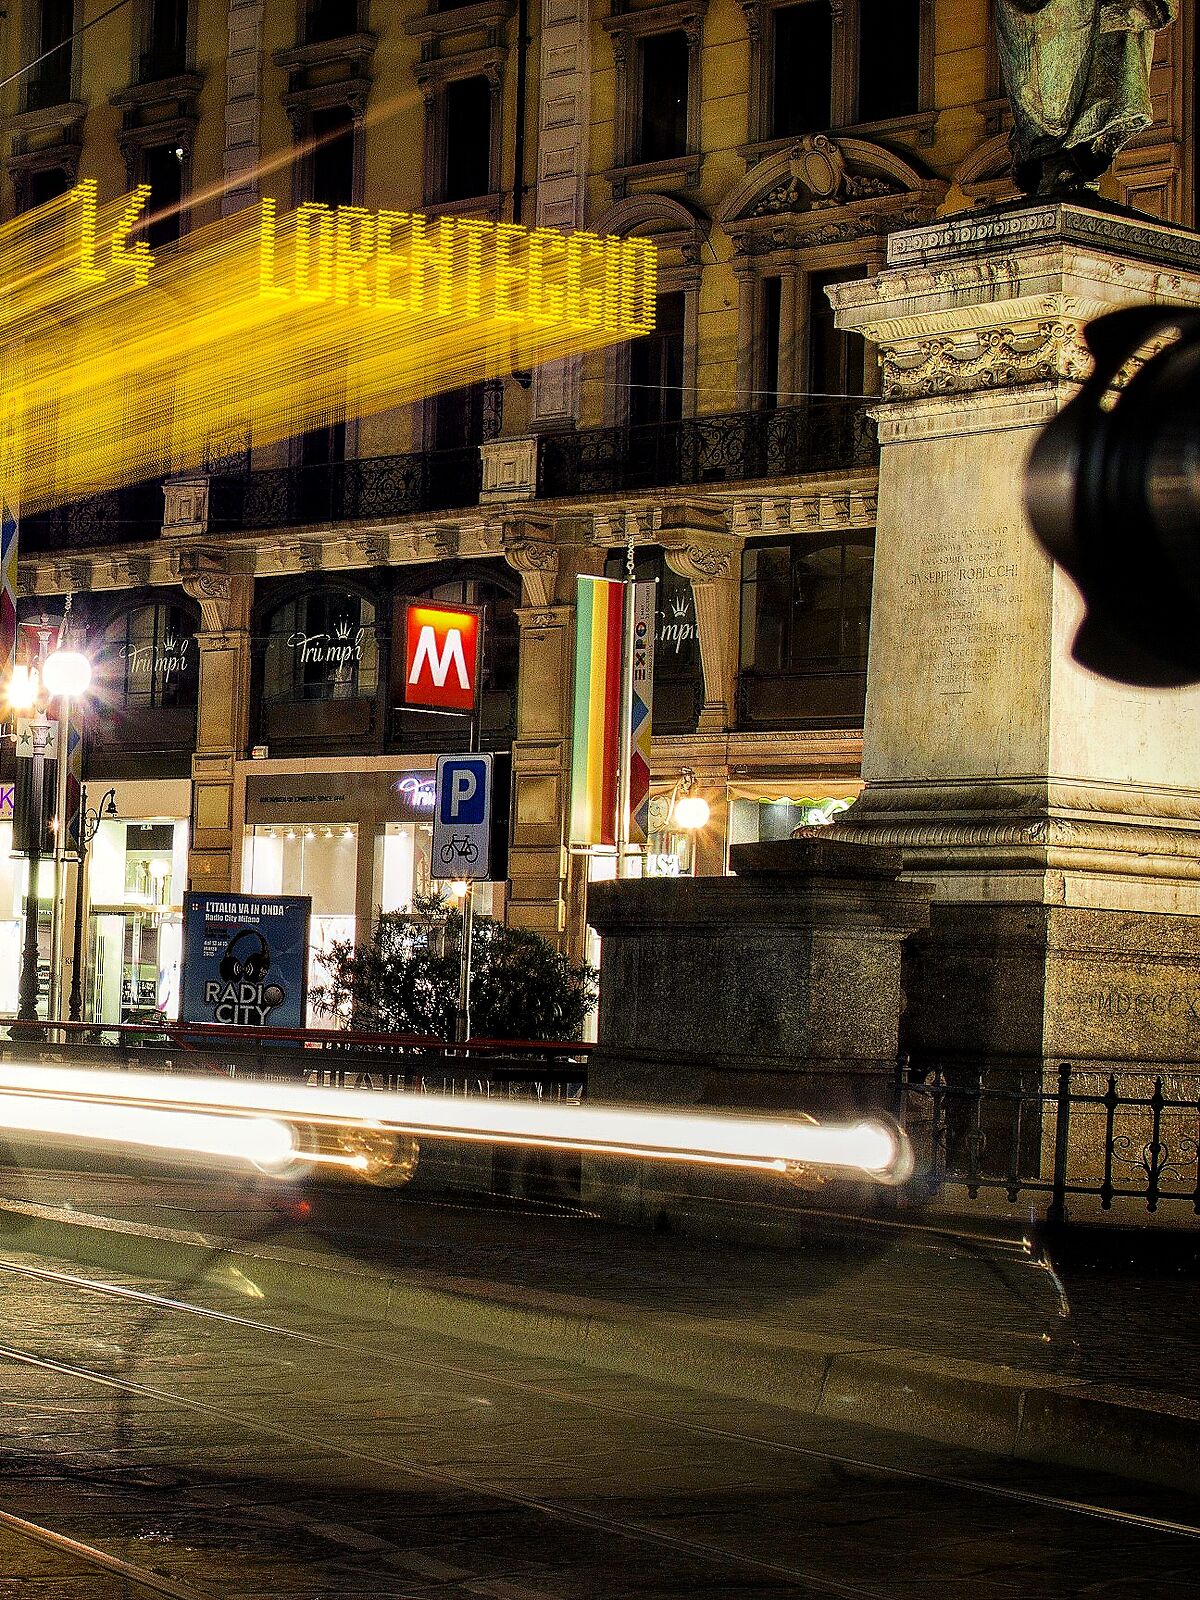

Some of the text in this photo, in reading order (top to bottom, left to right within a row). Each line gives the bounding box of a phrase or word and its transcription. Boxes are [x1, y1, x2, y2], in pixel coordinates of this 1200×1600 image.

[71, 179, 658, 334] 14 LORENTEGGIO
[119, 639, 189, 683] Triumph
[287, 628, 365, 673] Triumph
[408, 626, 471, 690] M
[635, 621, 647, 681] EXPO
[450, 769, 477, 817] P
[205, 901, 284, 916] L'ITALIA VA IN ONDA
[205, 913, 260, 924] Radio City Milano
[205, 982, 284, 1005] RADIO
[215, 1004, 271, 1026] CITY
